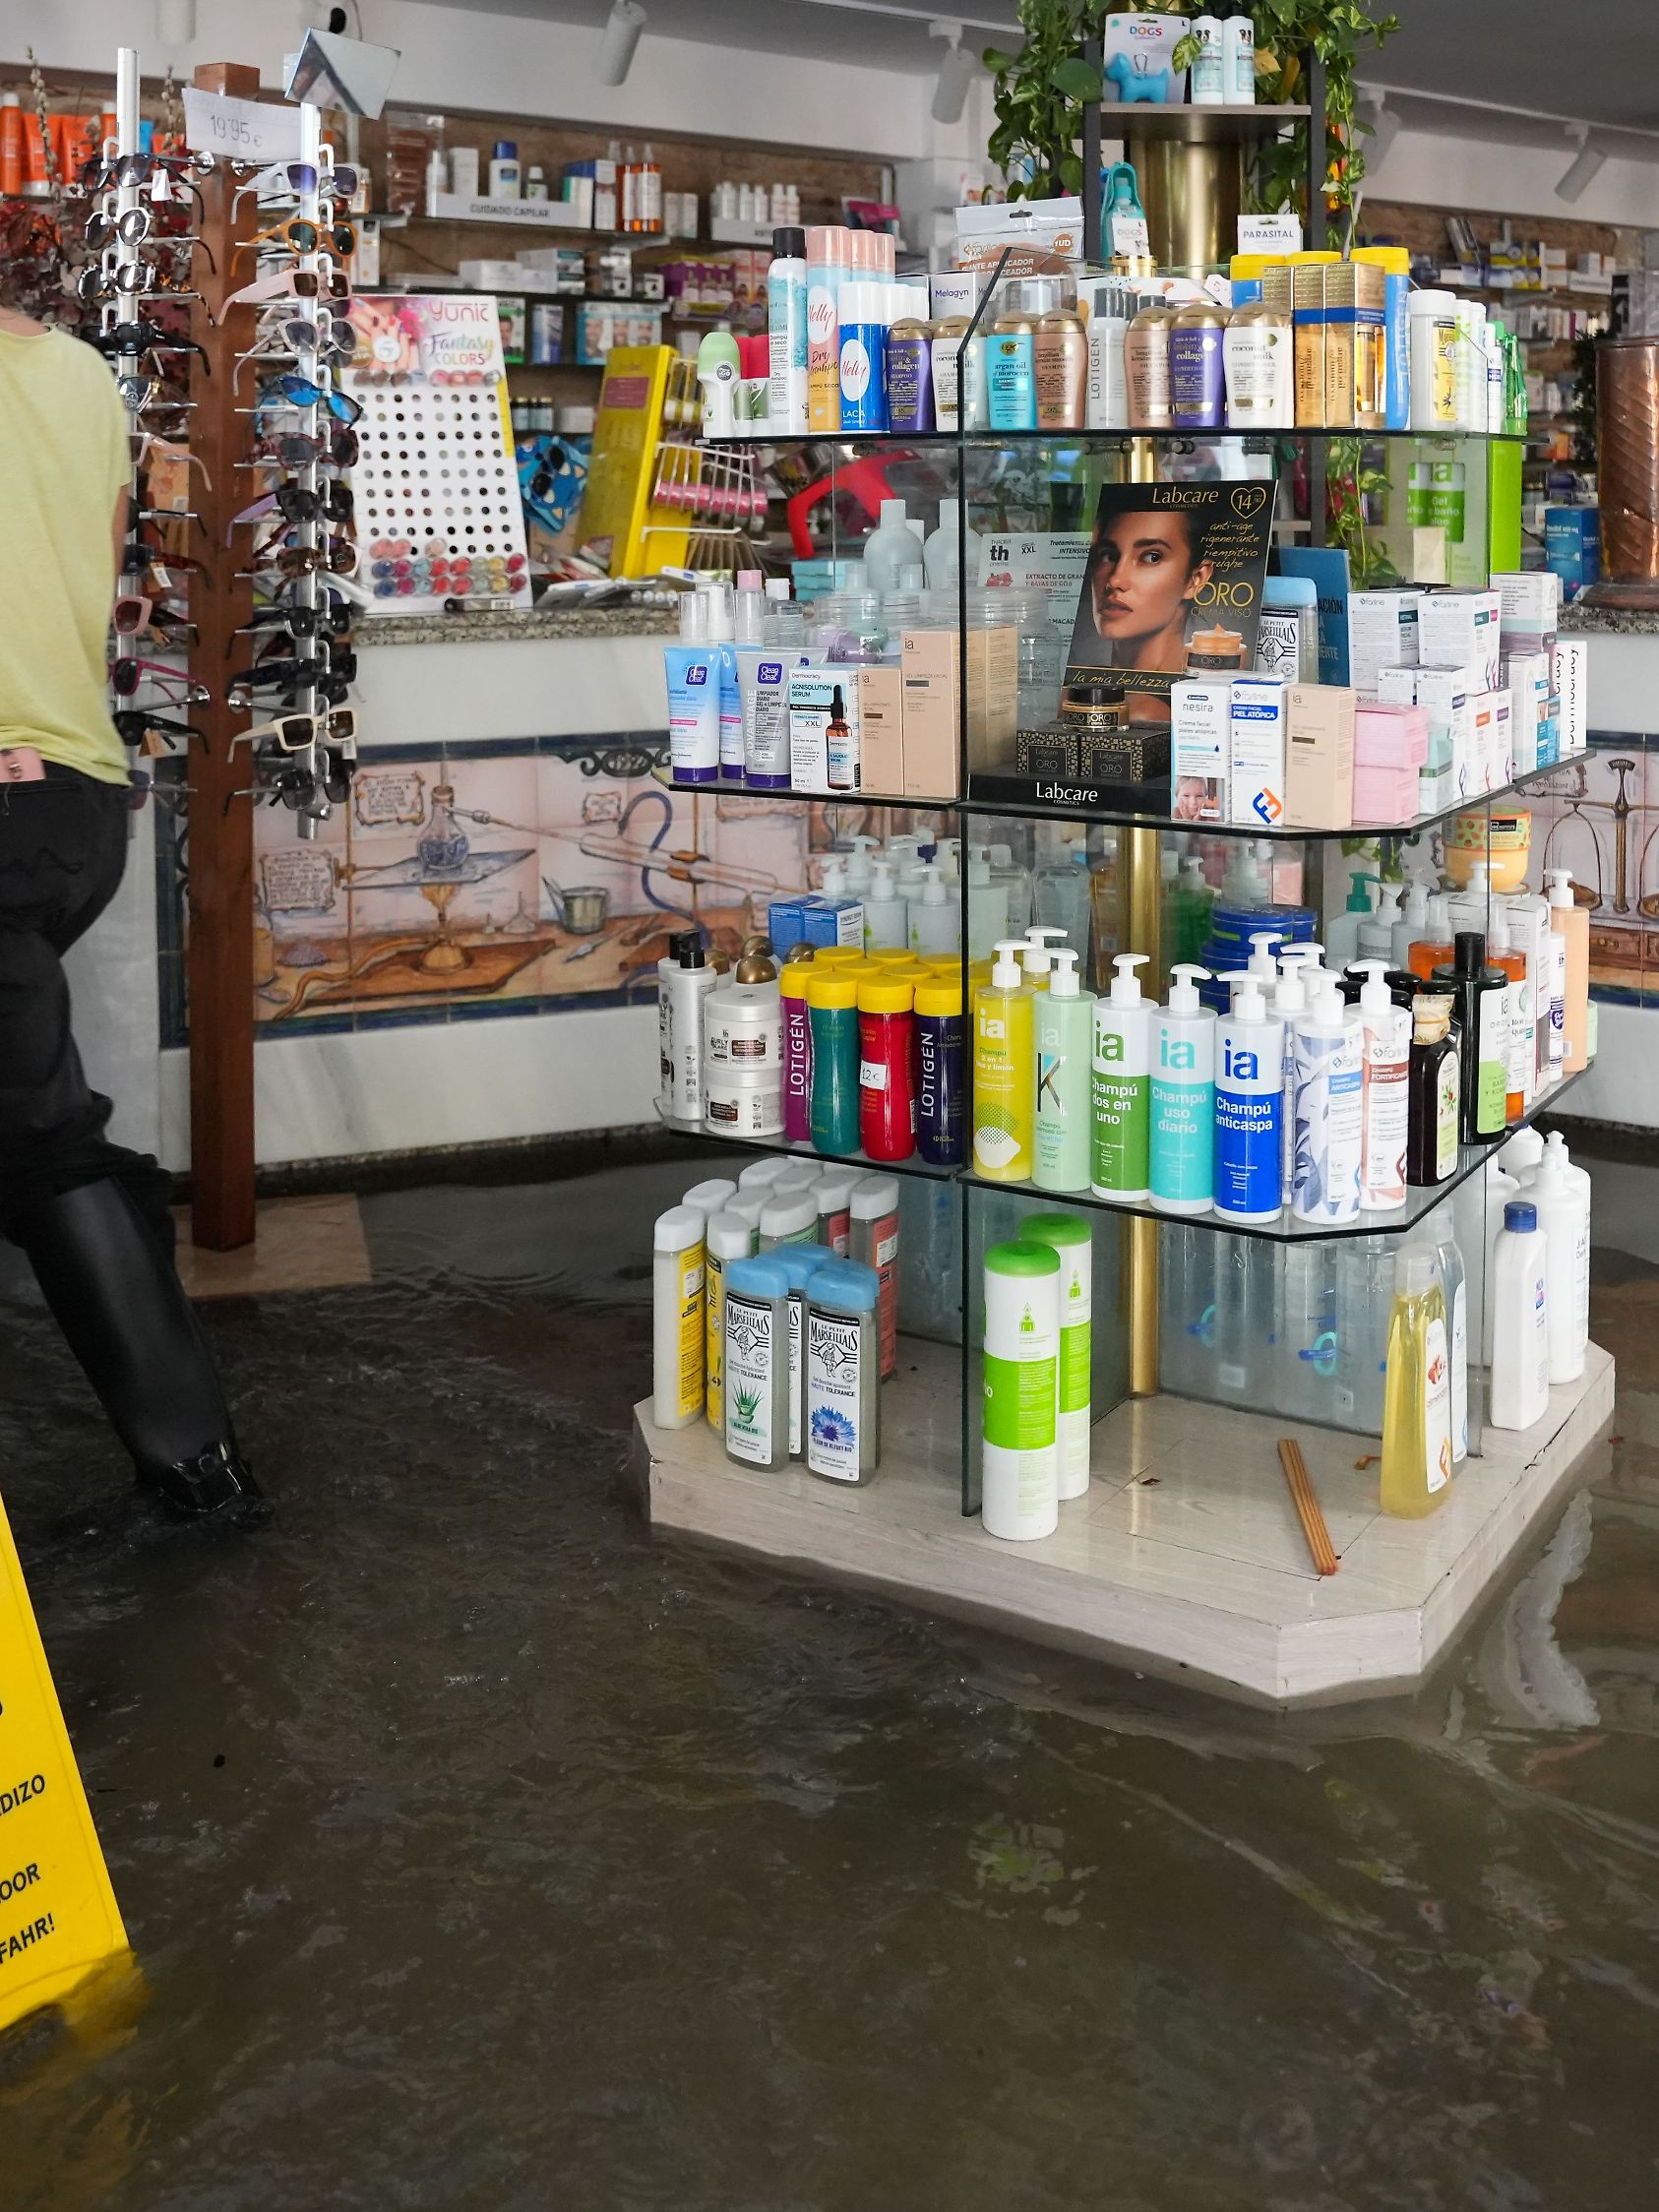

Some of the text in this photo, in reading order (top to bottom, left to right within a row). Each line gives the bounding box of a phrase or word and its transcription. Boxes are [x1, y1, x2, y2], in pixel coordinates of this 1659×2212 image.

[1129, 26, 1163, 36] DOGS
[469, 203, 550, 218] CUIDADO CAPILAR
[1243, 230, 1294, 239] PARASITAL
[987, 258, 1034, 269] APICADOR
[935, 288, 969, 299] Melagyn
[425, 331, 494, 361] Fantasy
[436, 352, 486, 366] COLORS
[812, 350, 830, 363] Dry
[842, 409, 866, 418] LACA
[1152, 486, 1252, 510] Labcare 14
[1209, 521, 1254, 535] anti-age
[1199, 532, 1260, 548] rigenerante
[990, 545, 1036, 561] th XXL
[1203, 546, 1259, 559] riempitivo
[1211, 559, 1244, 573] rughe
[1194, 582, 1255, 607] ORO
[1228, 607, 1252, 618] VISO
[1318, 596, 1344, 615] ACIÓN
[904, 638, 914, 650] ia
[1200, 656, 1221, 665] ORO
[761, 665, 779, 674] Clean
[862, 674, 870, 684] ia
[1073, 670, 1171, 689] la mia bellezza
[1292, 693, 1302, 704] ia
[1182, 703, 1213, 712] nesira
[1248, 710, 1276, 719] ATÓPICA
[1069, 712, 1111, 722] ORO ORO
[1035, 759, 1058, 769] ORO
[1099, 763, 1123, 774] ORO
[1036, 781, 1098, 802] Labcare
[980, 1008, 1006, 1039] ia
[1041, 1021, 1061, 1047] ia
[1095, 1019, 1125, 1062] ia
[789, 1014, 804, 1096] LOTIGÉN
[979, 1046, 1007, 1057] Champú
[1160, 1028, 1196, 1070] ia
[1224, 1038, 1259, 1080] ia
[993, 1063, 1014, 1072] limón
[921, 1032, 935, 1118] LOTIGÉN
[1092, 1092, 1132, 1111] dos en
[1152, 1085, 1207, 1107] Champú
[1216, 1096, 1271, 1116] Champú
[1097, 1112, 1121, 1125] uno
[1164, 1108, 1191, 1119] uso
[1158, 1118, 1198, 1134] diario
[1215, 1114, 1273, 1134] anticaspa
[727, 1303, 769, 1335] MARSEILLAIS
[810, 1321, 858, 1351] MARSEILLAIS
[740, 1369, 768, 1382] TOLERANCE
[826, 1385, 855, 1397] TOLERANCE
